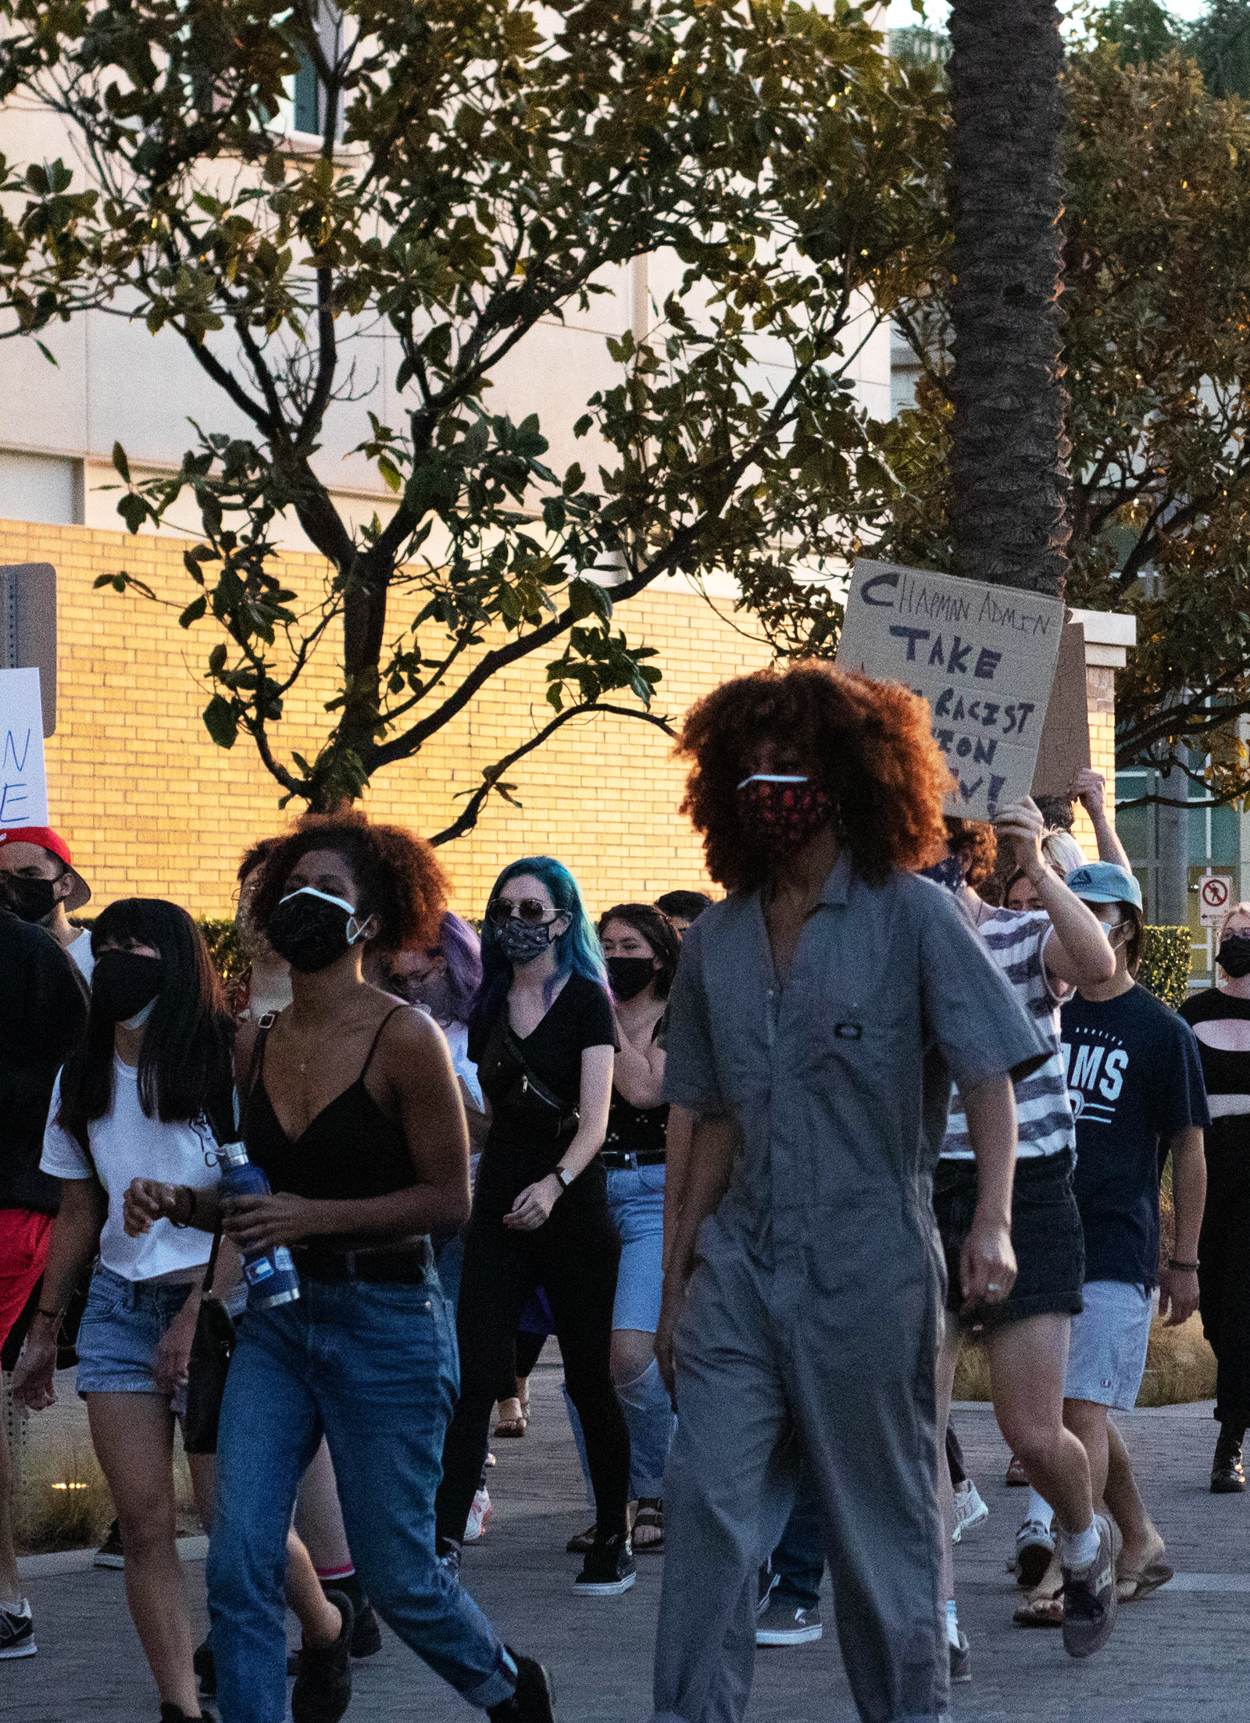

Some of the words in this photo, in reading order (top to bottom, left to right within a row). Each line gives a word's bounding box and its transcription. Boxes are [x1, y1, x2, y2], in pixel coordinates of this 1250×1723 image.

[860, 573, 969, 621] CHAPMAN
[979, 591, 1050, 635] ADMIN
[889, 625, 1002, 679] TAKE
[935, 687, 1035, 734] RACIST
[931, 728, 998, 766] ION
